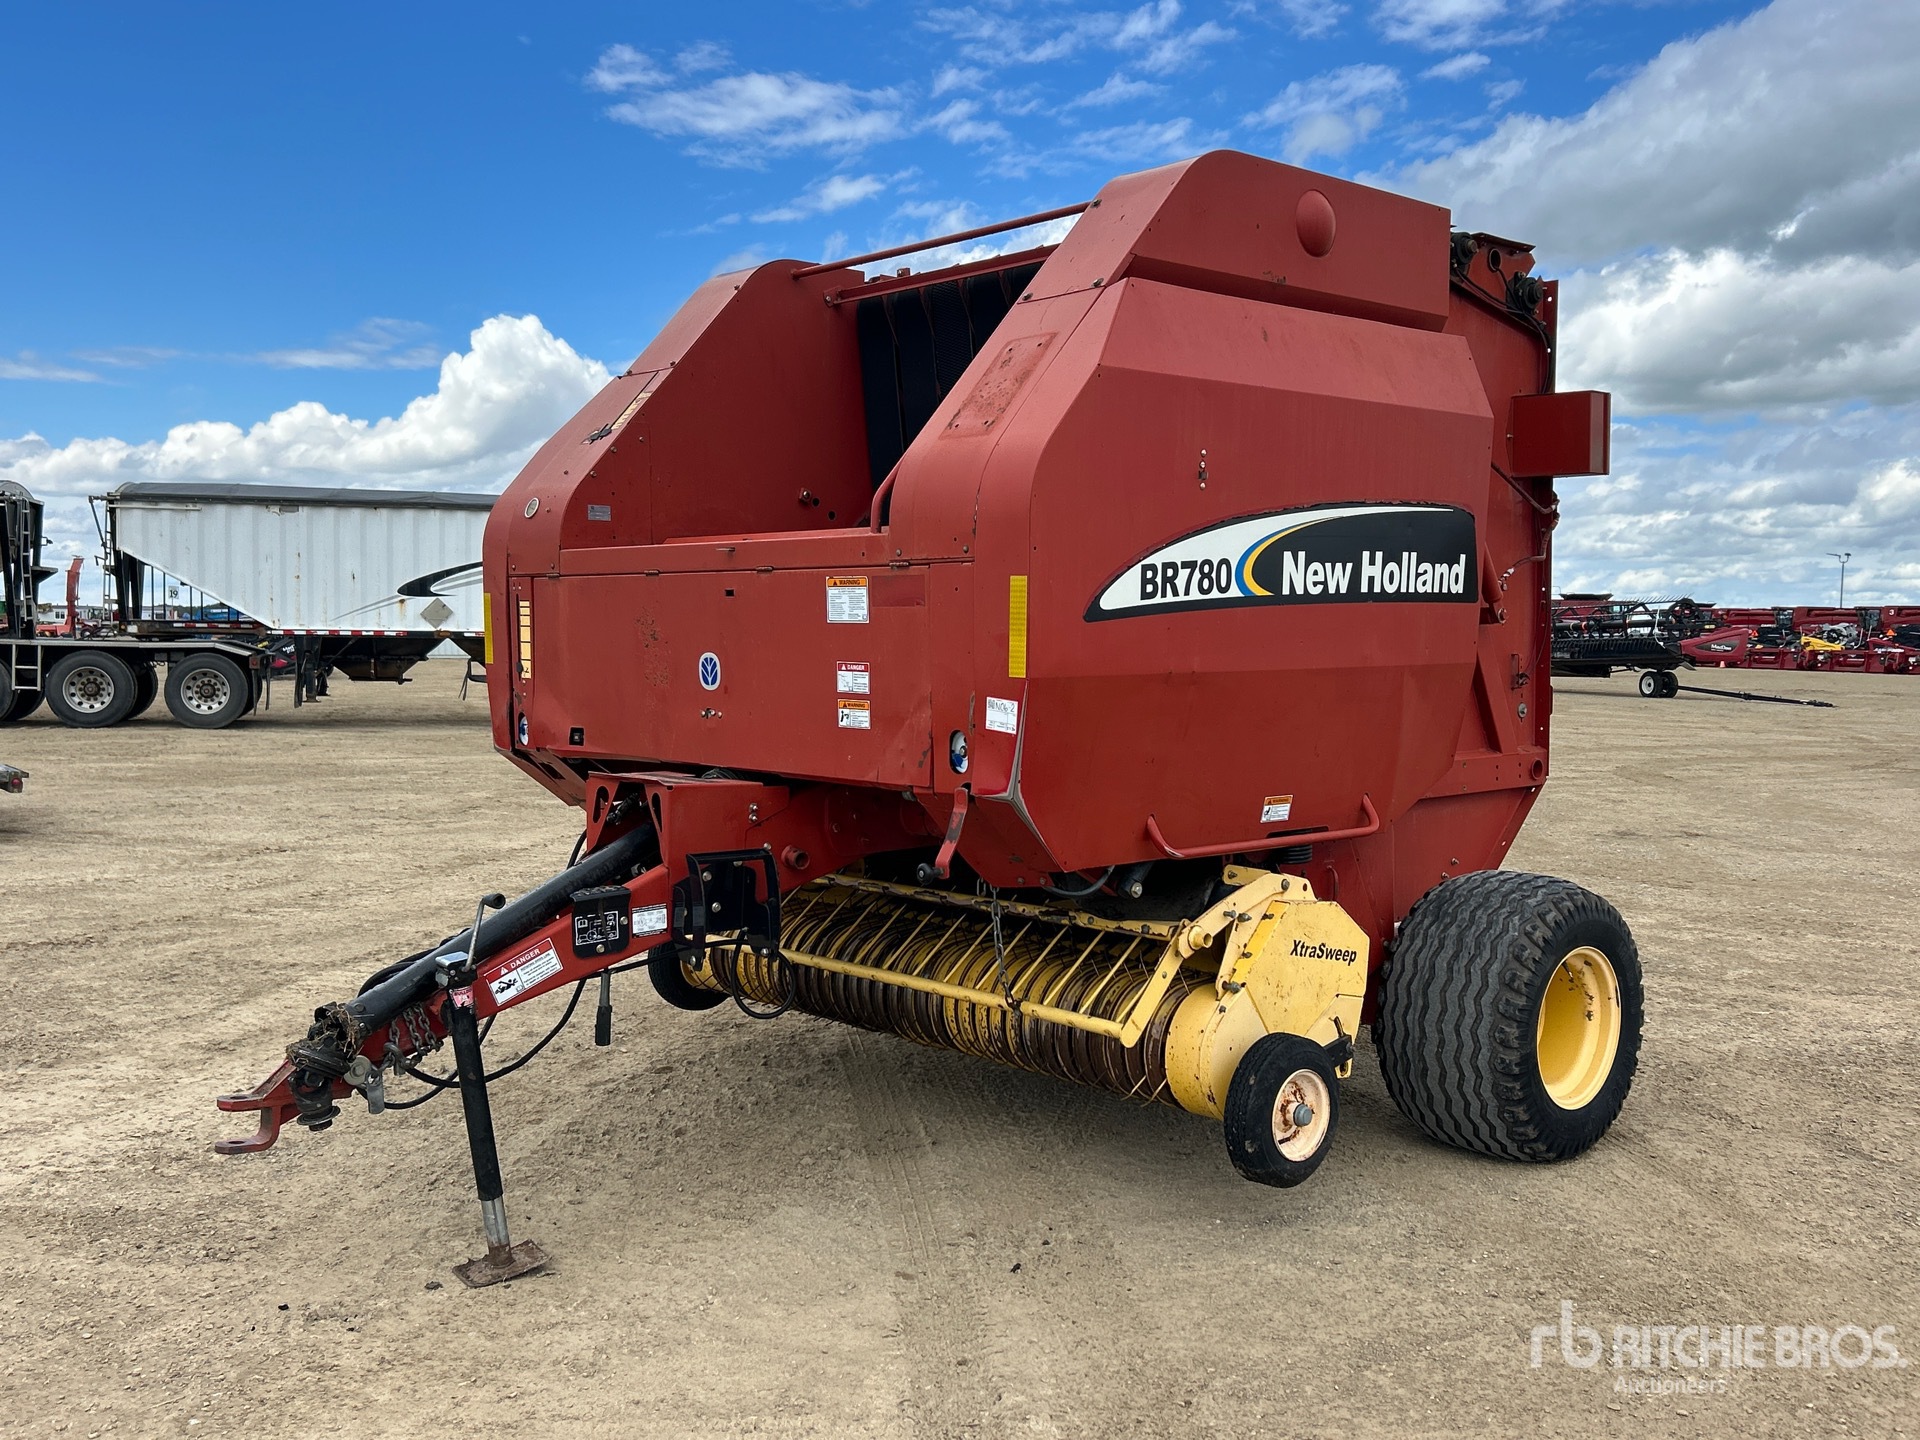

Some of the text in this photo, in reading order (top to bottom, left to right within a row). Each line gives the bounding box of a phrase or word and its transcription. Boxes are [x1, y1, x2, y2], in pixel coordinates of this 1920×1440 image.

[1140, 557, 1232, 600] BR780
[1281, 550, 1466, 595] New Holland
[169, 589, 179, 598] 19
[510, 948, 541, 969] DANGER
[1290, 939, 1357, 966] XtraSweep
